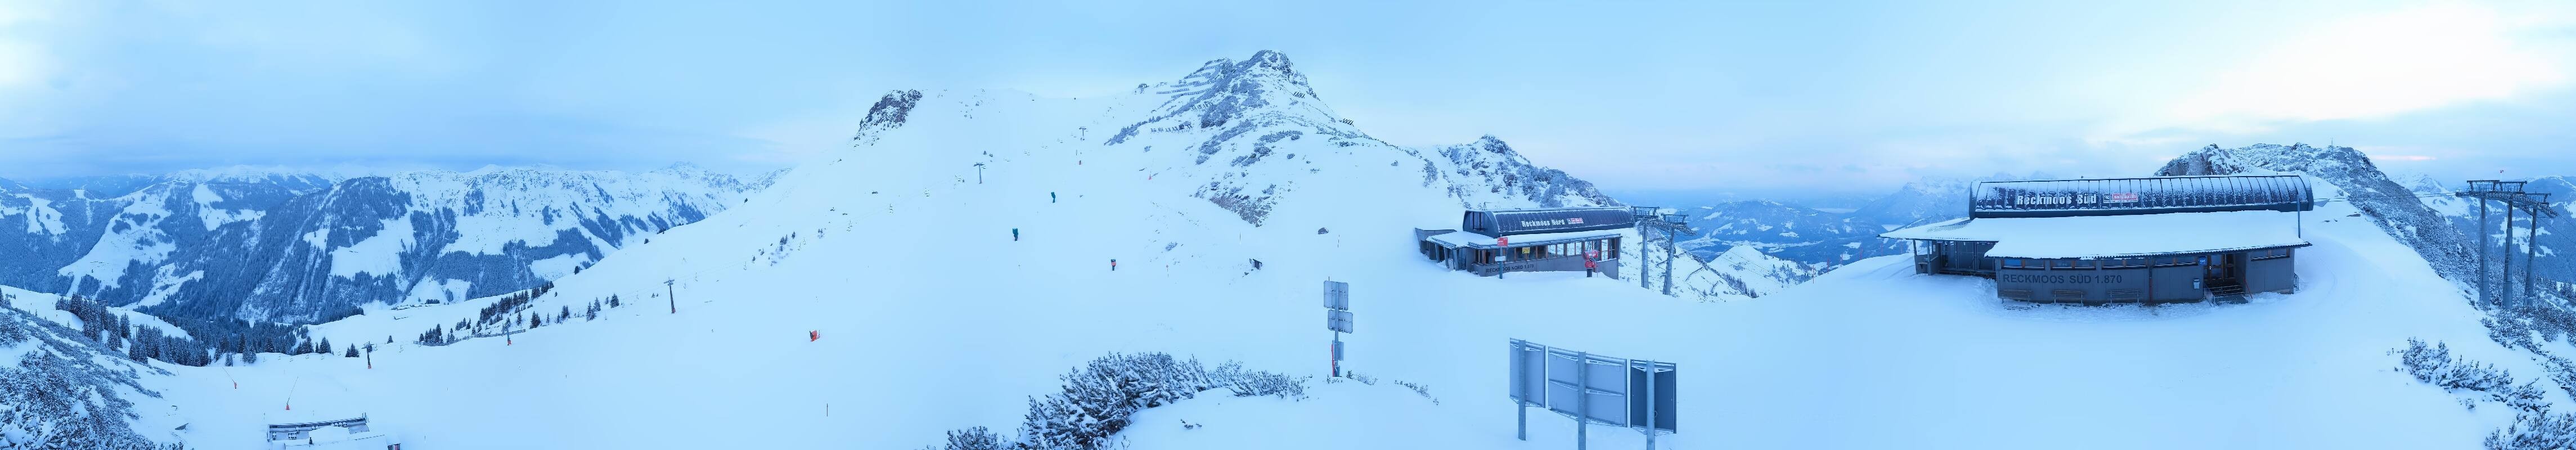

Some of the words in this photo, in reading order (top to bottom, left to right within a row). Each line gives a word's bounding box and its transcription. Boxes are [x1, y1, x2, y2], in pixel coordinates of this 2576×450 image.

[2017, 195, 2072, 205] Reckmoos
[2078, 194, 2097, 204] Süd
[2003, 274, 2065, 284] RECKMOOS
[2070, 273, 2092, 284] SÜD
[2094, 274, 2122, 284] 1.870
